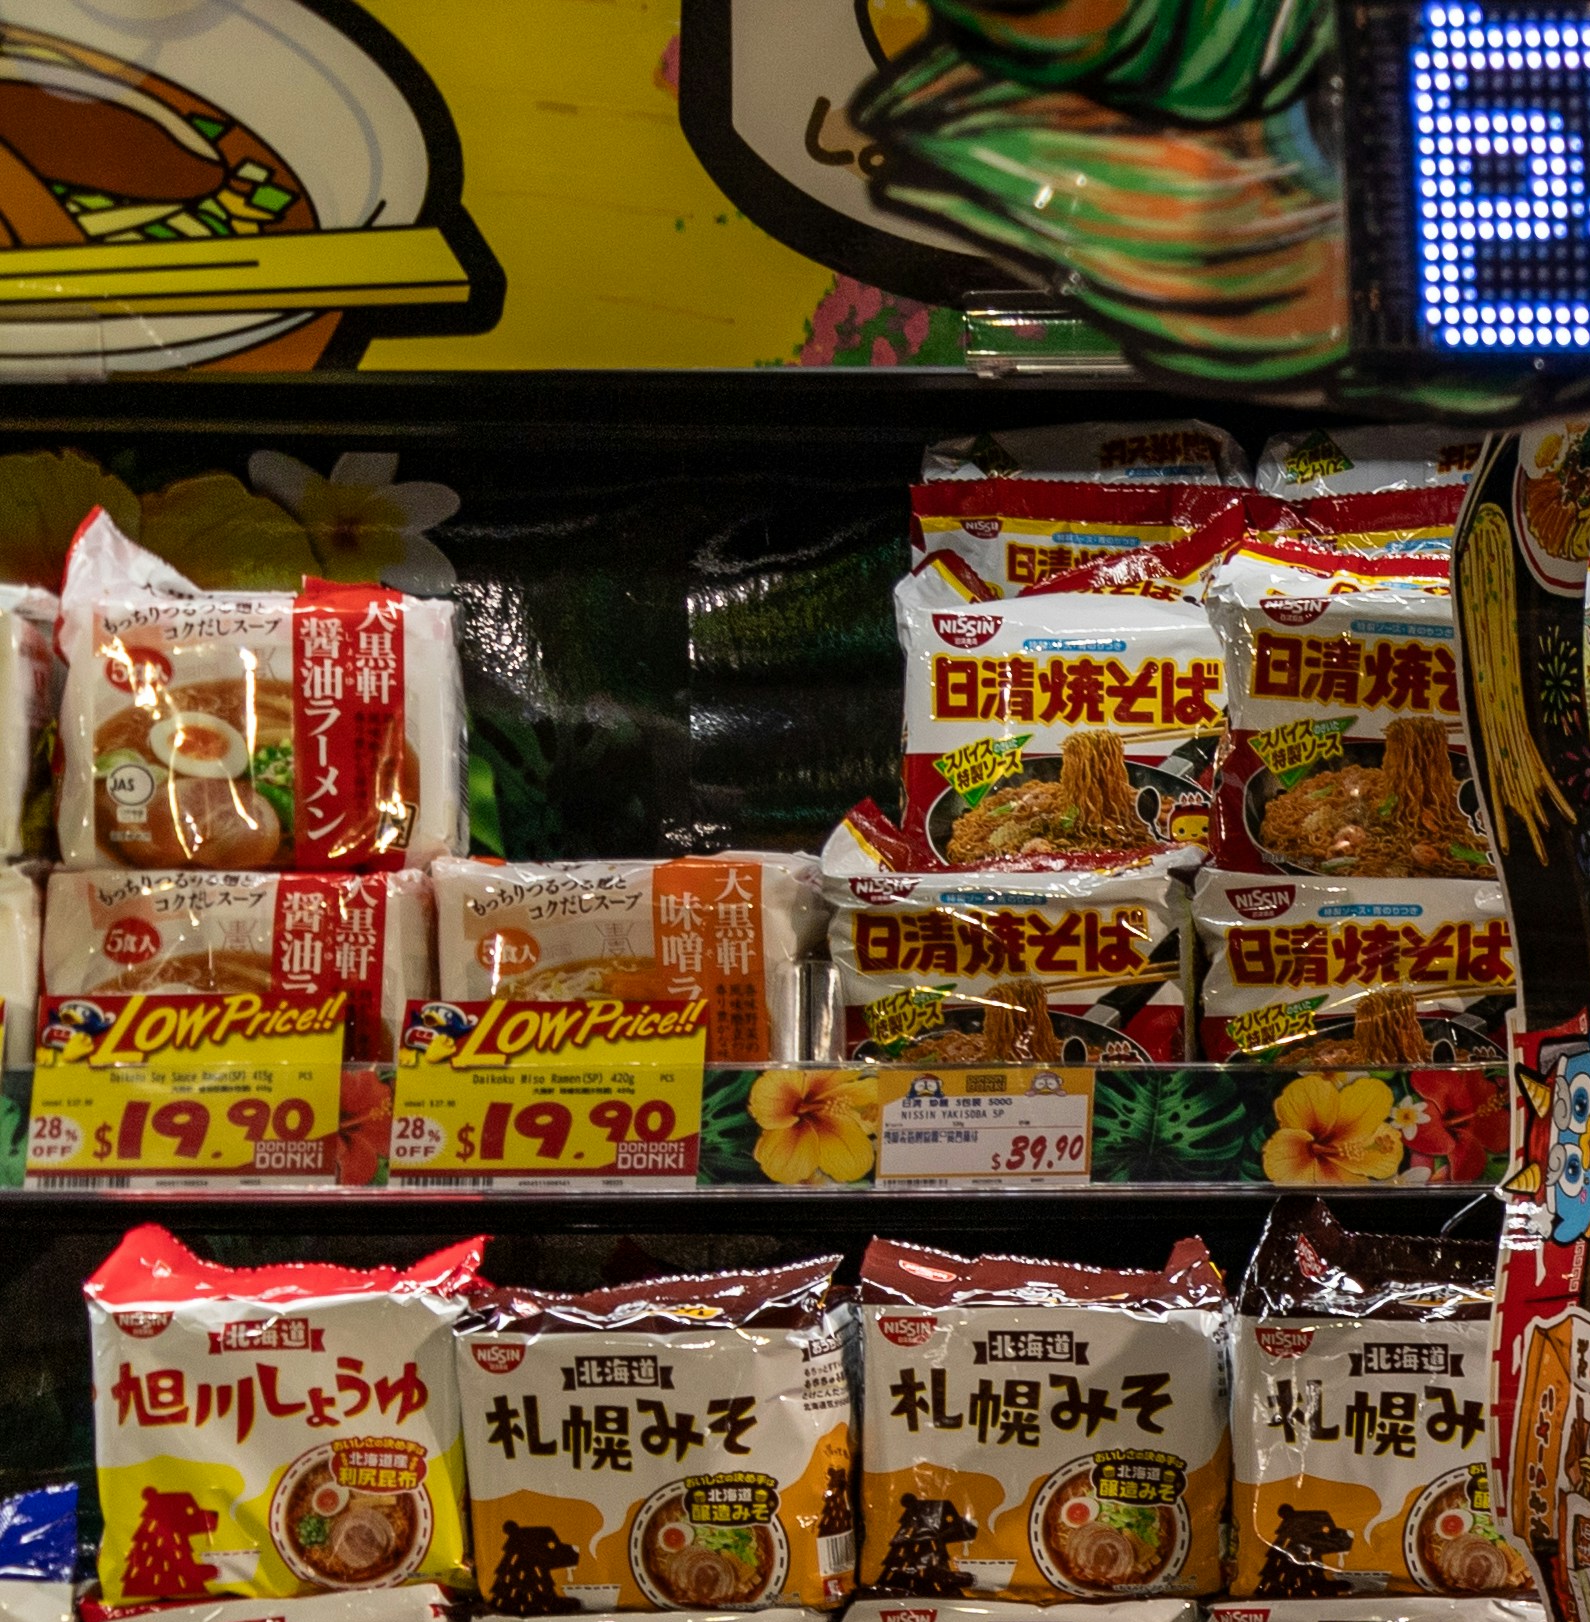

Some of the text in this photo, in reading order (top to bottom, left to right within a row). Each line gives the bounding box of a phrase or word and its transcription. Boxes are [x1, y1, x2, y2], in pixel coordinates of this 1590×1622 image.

[939, 617, 995, 638] NISSIN
[935, 657, 1221, 725] 日清焼そば
[110, 778, 135, 791] JAS
[714, 869, 756, 975] 大黒軒
[855, 911, 1148, 974] 日清焼そば
[1228, 926, 1514, 986] 日清焼そば
[34, 1116, 78, 1143] 28%
[94, 1099, 314, 1160] $19.90
[397, 1116, 441, 1142] 28%
[456, 1100, 676, 1162] $19.90
[901, 1110, 936, 1120] NISSIN
[32, 1146, 72, 1158] OFF
[395, 1146, 435, 1158] OFF
[991, 1134, 1084, 1170] $39.90
[989, 1332, 1075, 1362] 北海道
[1368, 1347, 1446, 1372] 北海道
[574, 1358, 659, 1386] 北海道
[111, 1357, 428, 1445] 旭川しょうゆ
[889, 1368, 1173, 1447] 札幌みそ
[486, 1395, 759, 1473] 札幌みそ
